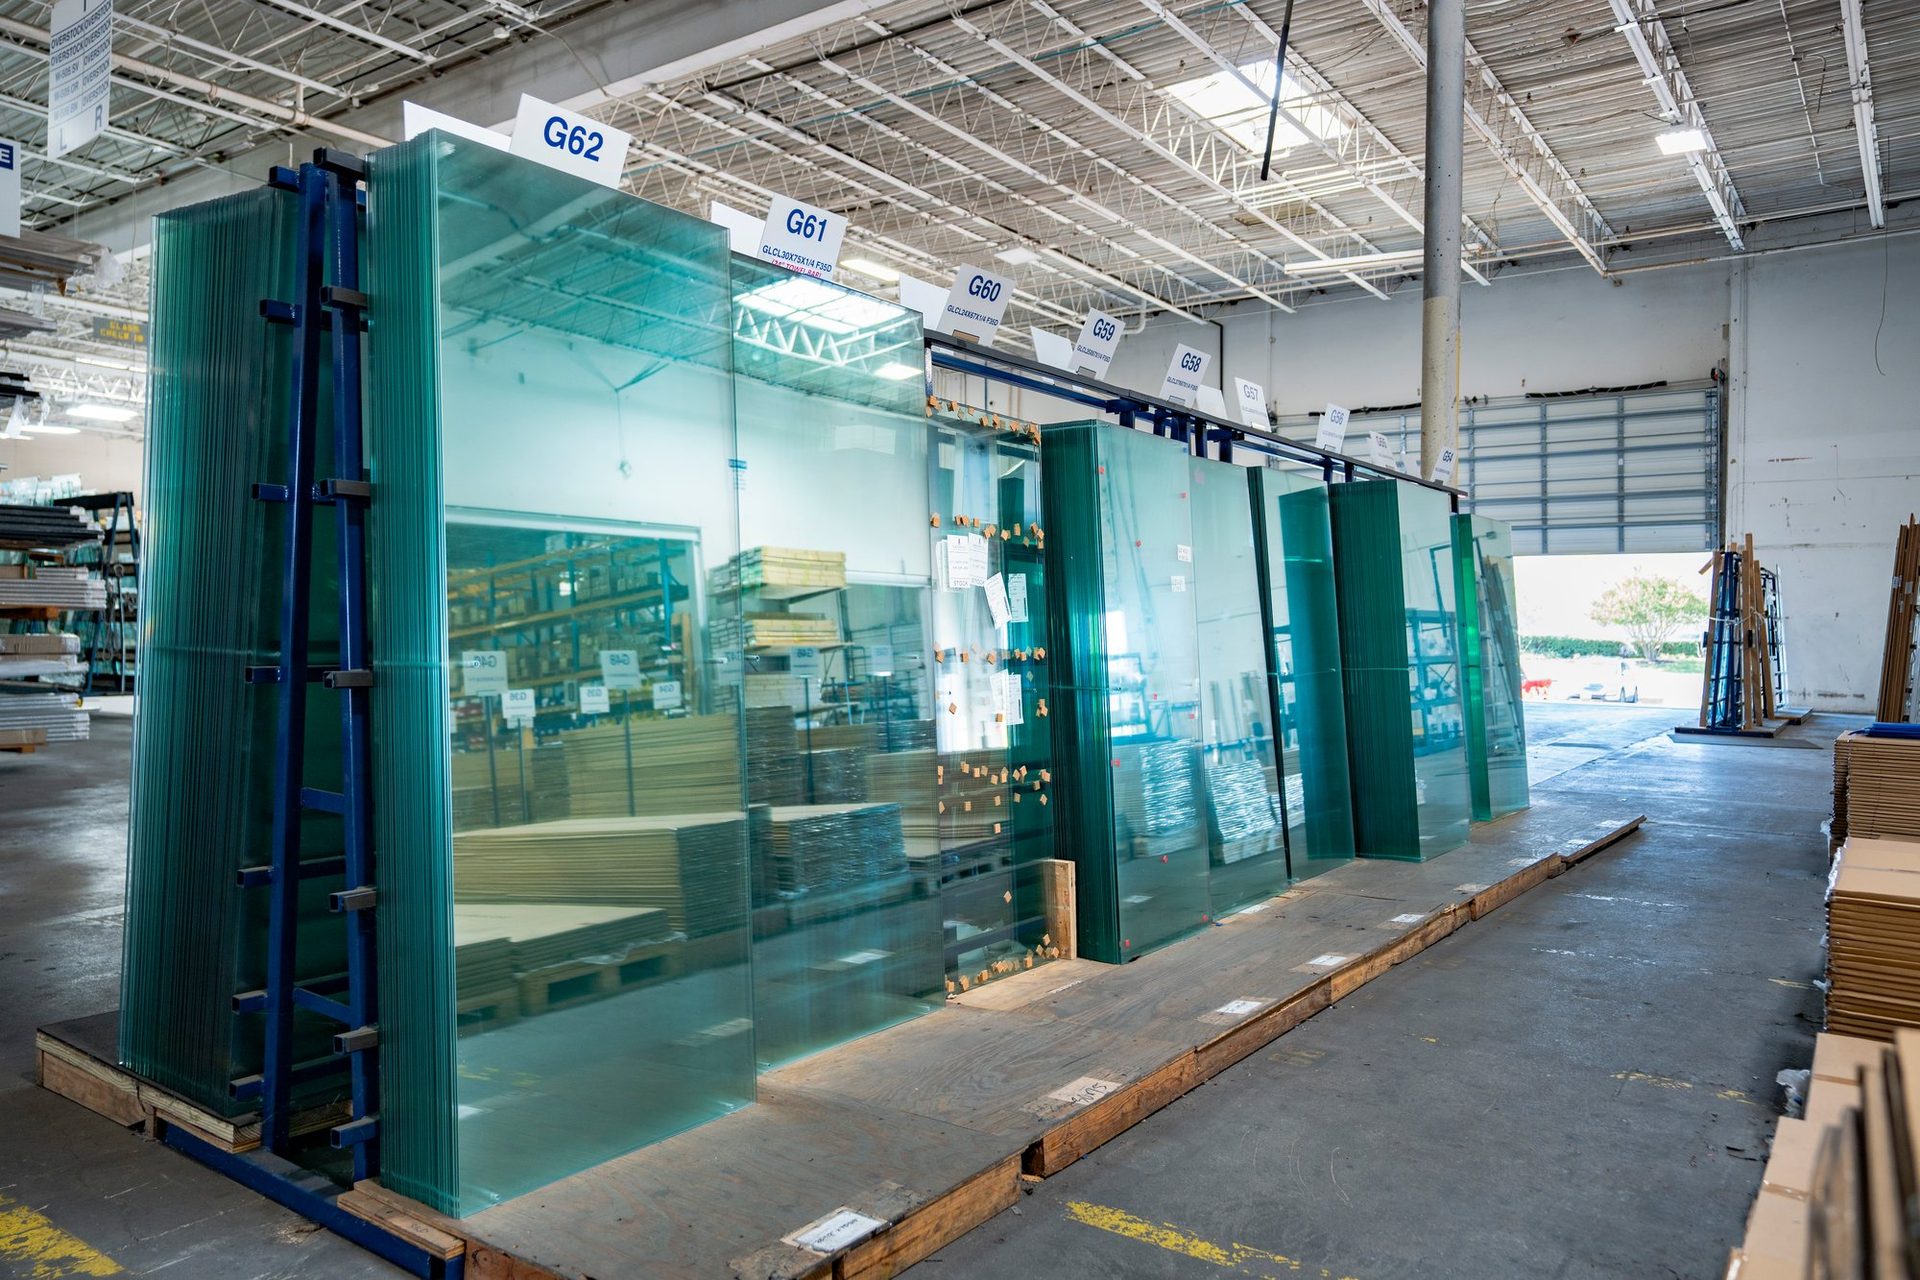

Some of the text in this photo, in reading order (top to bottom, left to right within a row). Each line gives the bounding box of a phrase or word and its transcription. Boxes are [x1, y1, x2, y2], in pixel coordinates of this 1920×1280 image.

[51, 23, 84, 49] OVERSTOCK
[84, 1, 111, 29] OVERSTOCK
[51, 18, 111, 66] OVERSTOCK OVERSTOCK
[83, 37, 110, 66] OVERSTOCK
[82, 58, 109, 86] OVERSTOCK
[94, 104, 103, 132] R
[543, 115, 604, 162] G62
[786, 208, 827, 242] G61
[762, 245, 833, 272] GLCL30X75X1/4 F35D
[969, 274, 1001, 302] G60
[1093, 318, 1116, 342] G59
[1181, 352, 1202, 373] G58
[1243, 384, 1258, 401] G57
[1330, 409, 1345, 425] G56
[1442, 450, 1454, 462] G54
